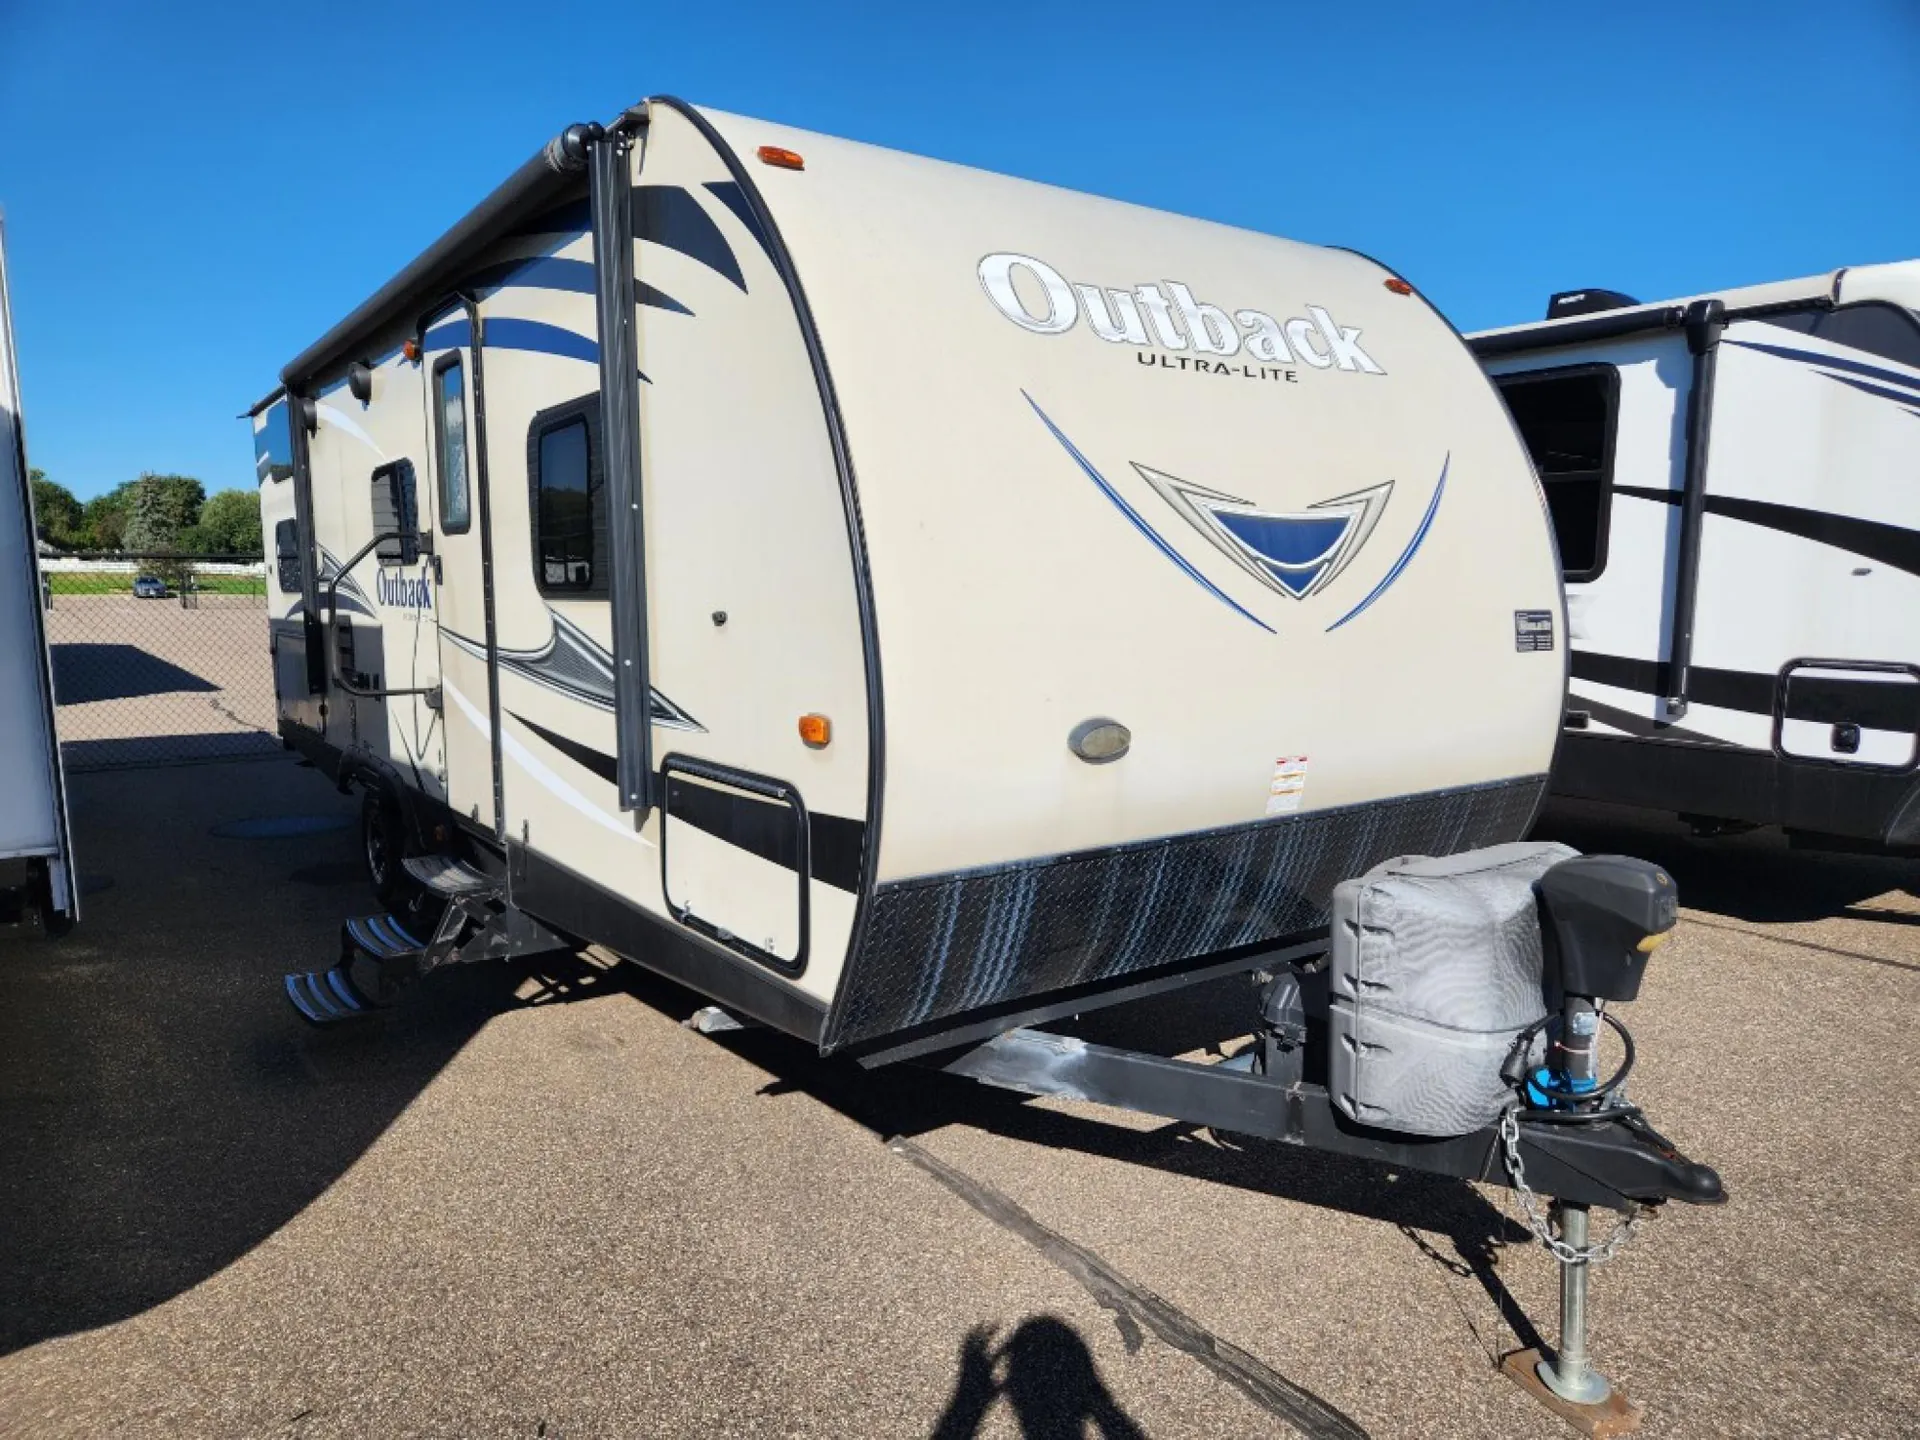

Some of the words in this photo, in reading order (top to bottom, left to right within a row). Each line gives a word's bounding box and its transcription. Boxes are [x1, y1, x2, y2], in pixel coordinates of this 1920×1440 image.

[977, 252, 1387, 375] Outback
[1136, 351, 1299, 383] ULTRA-LITE
[377, 567, 431, 609] Outback
